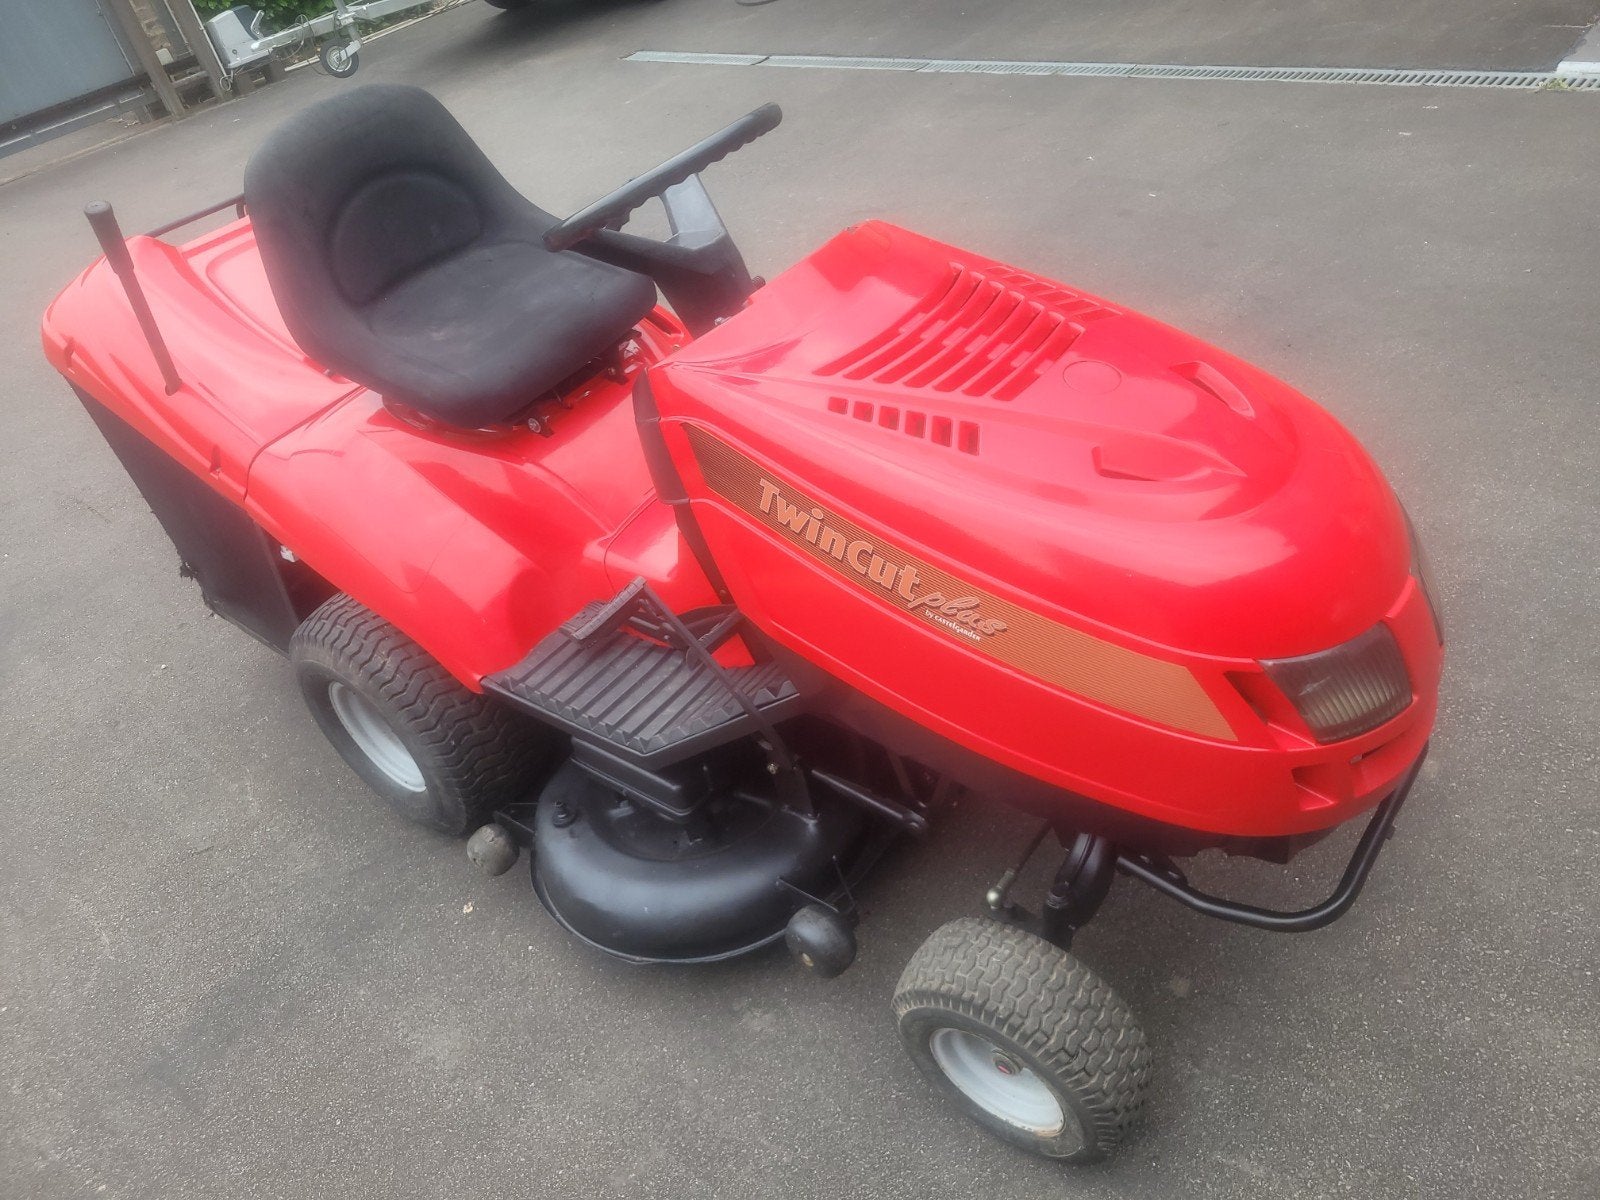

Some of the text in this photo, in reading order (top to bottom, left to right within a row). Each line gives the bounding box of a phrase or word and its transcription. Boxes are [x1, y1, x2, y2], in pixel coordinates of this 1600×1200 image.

[760, 477, 1008, 636] TwinCut plus
[925, 608, 936, 619] by
